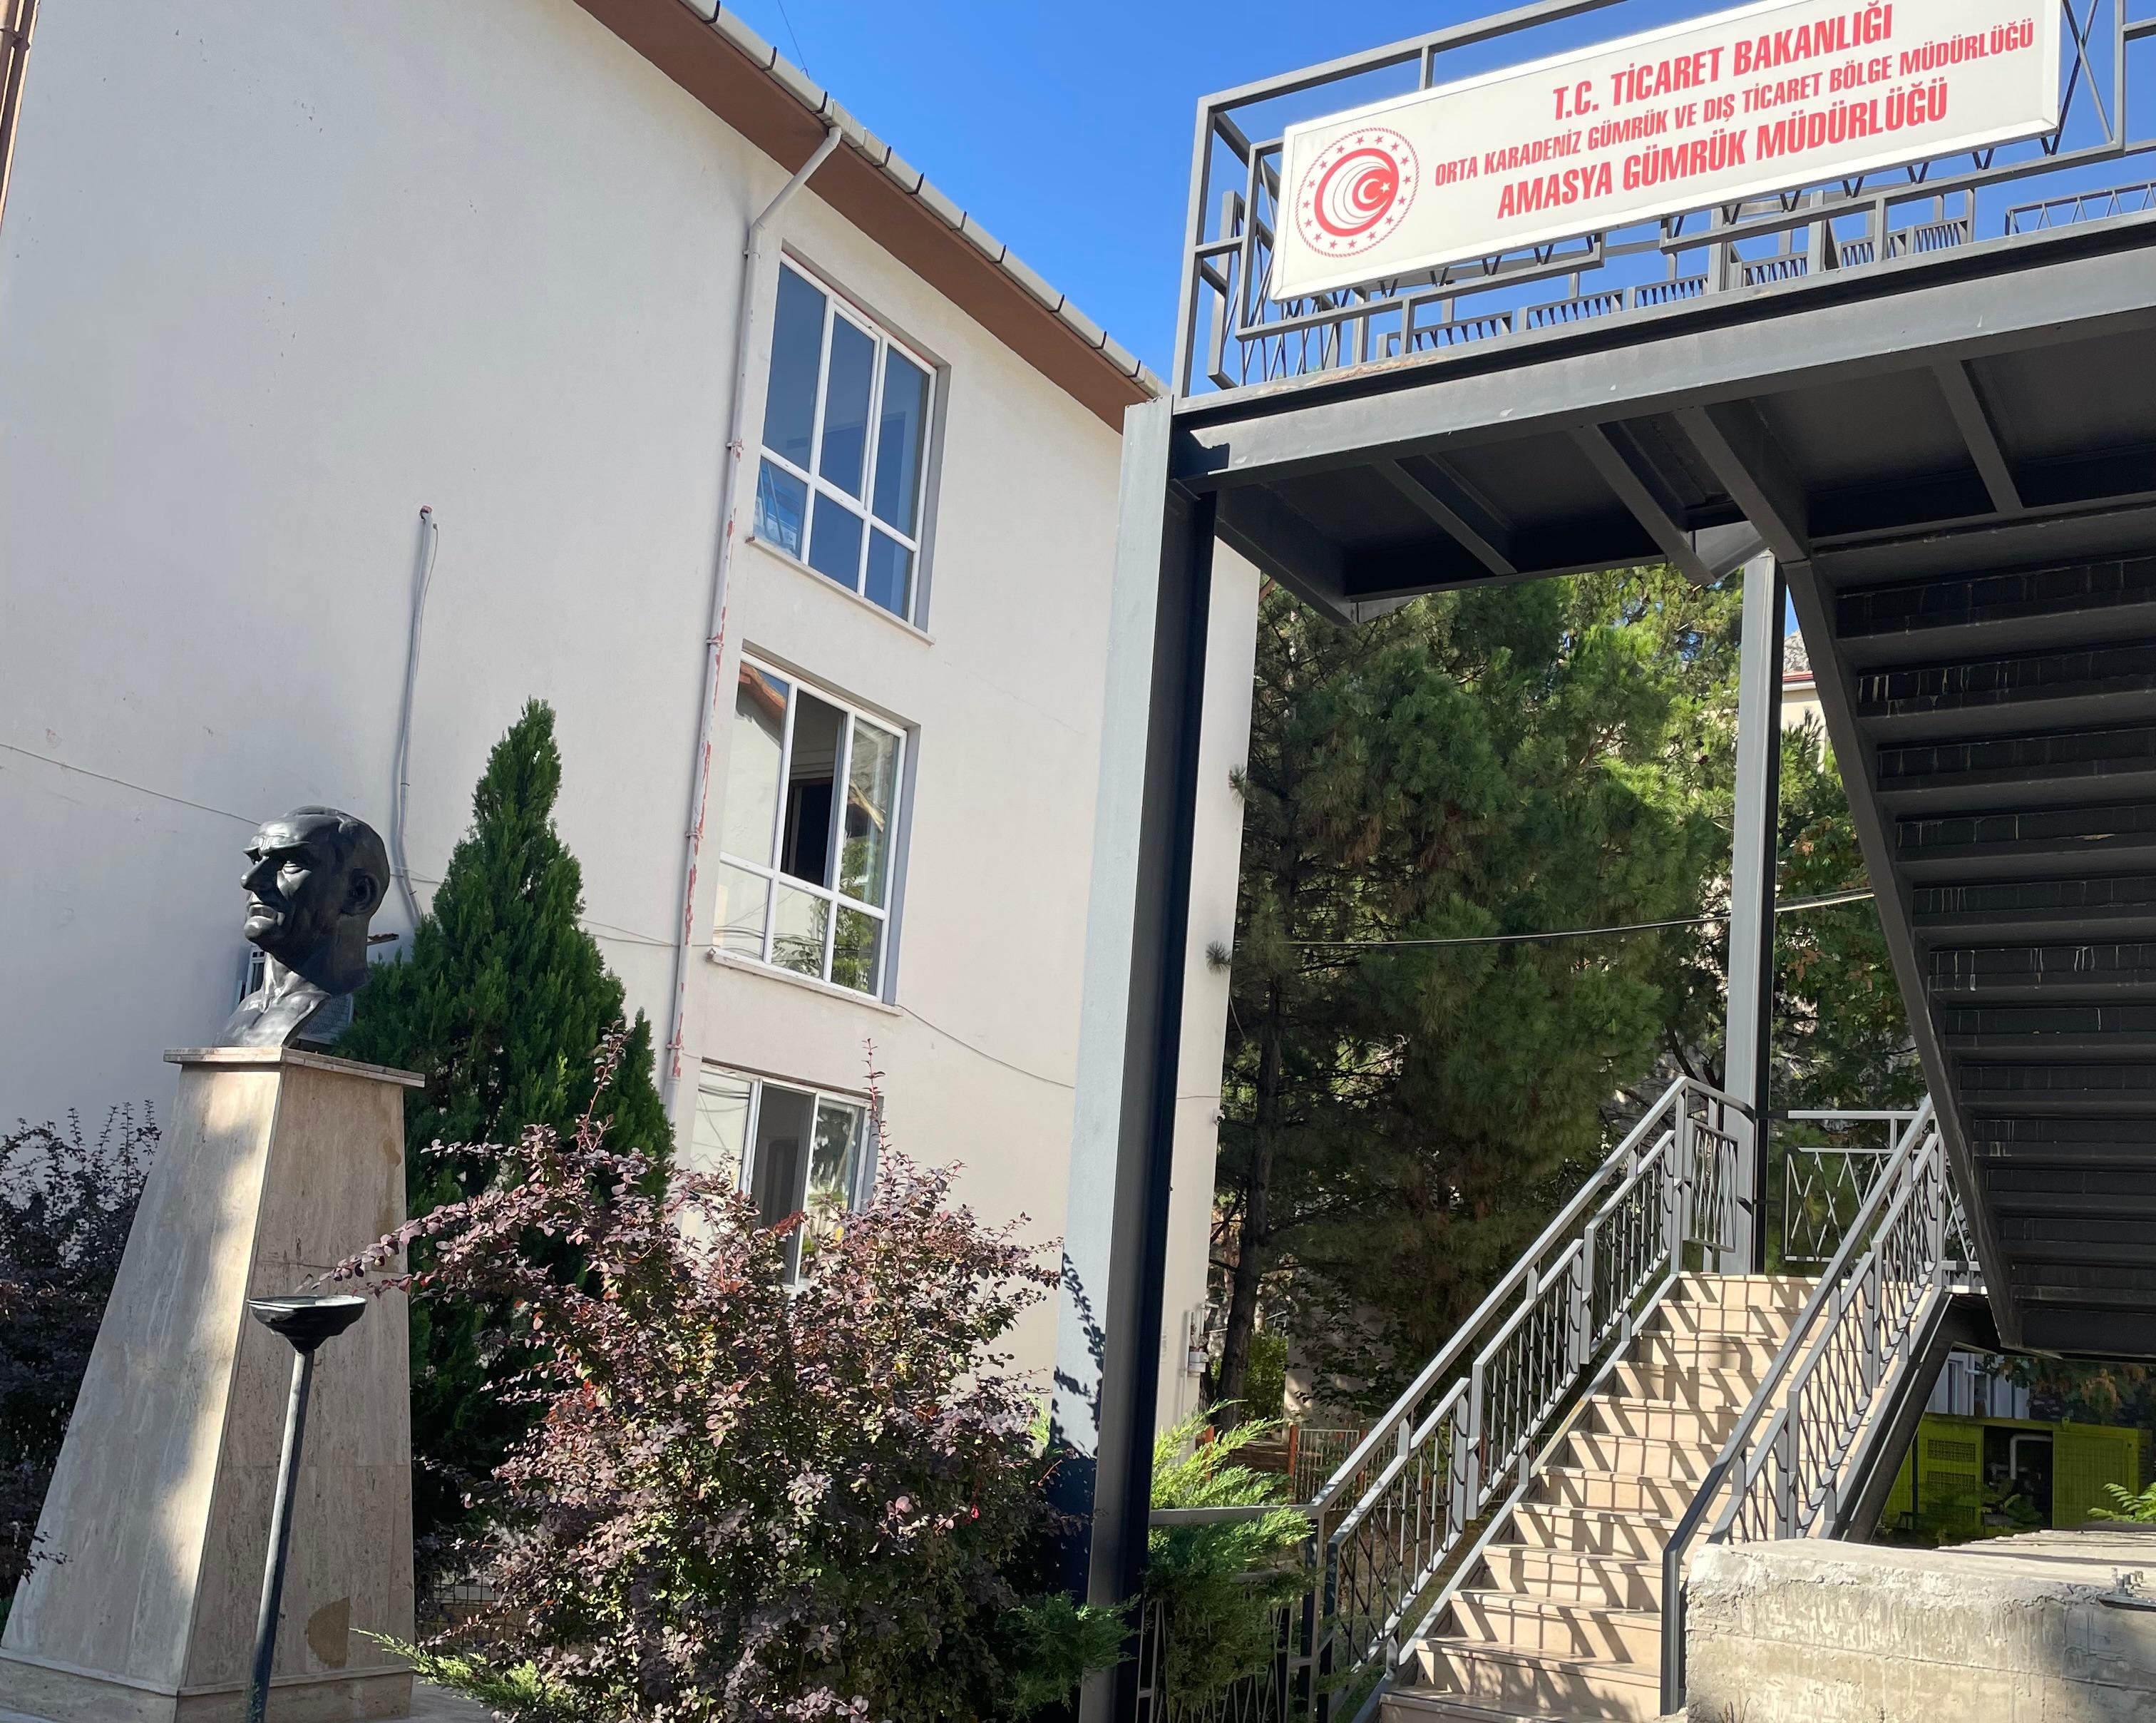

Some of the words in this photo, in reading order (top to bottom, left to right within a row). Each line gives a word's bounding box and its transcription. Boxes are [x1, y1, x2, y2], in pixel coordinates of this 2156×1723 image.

[1434, 158, 1478, 187] ORTA
[1484, 130, 1582, 176] KARADENİZ
[1588, 106, 1668, 151] GÜMRÜK
[1673, 102, 1698, 130] VE
[1703, 92, 1735, 123] DIŞ
[1742, 72, 1822, 114] TİCARET
[1829, 58, 1893, 93] BÖLGE
[1899, 18, 2034, 78] MÜDÜRLÜĞÜ
[1553, 80, 1598, 121] T.C.
[1611, 45, 1724, 108] TİCARET
[1733, 1, 1893, 77] BAKANLIĞI
[1497, 161, 1613, 220] AMASYA
[1622, 128, 1747, 193] GÜMRÜK
[1755, 77, 1949, 161] MÜDÜRLÜĞÜ
